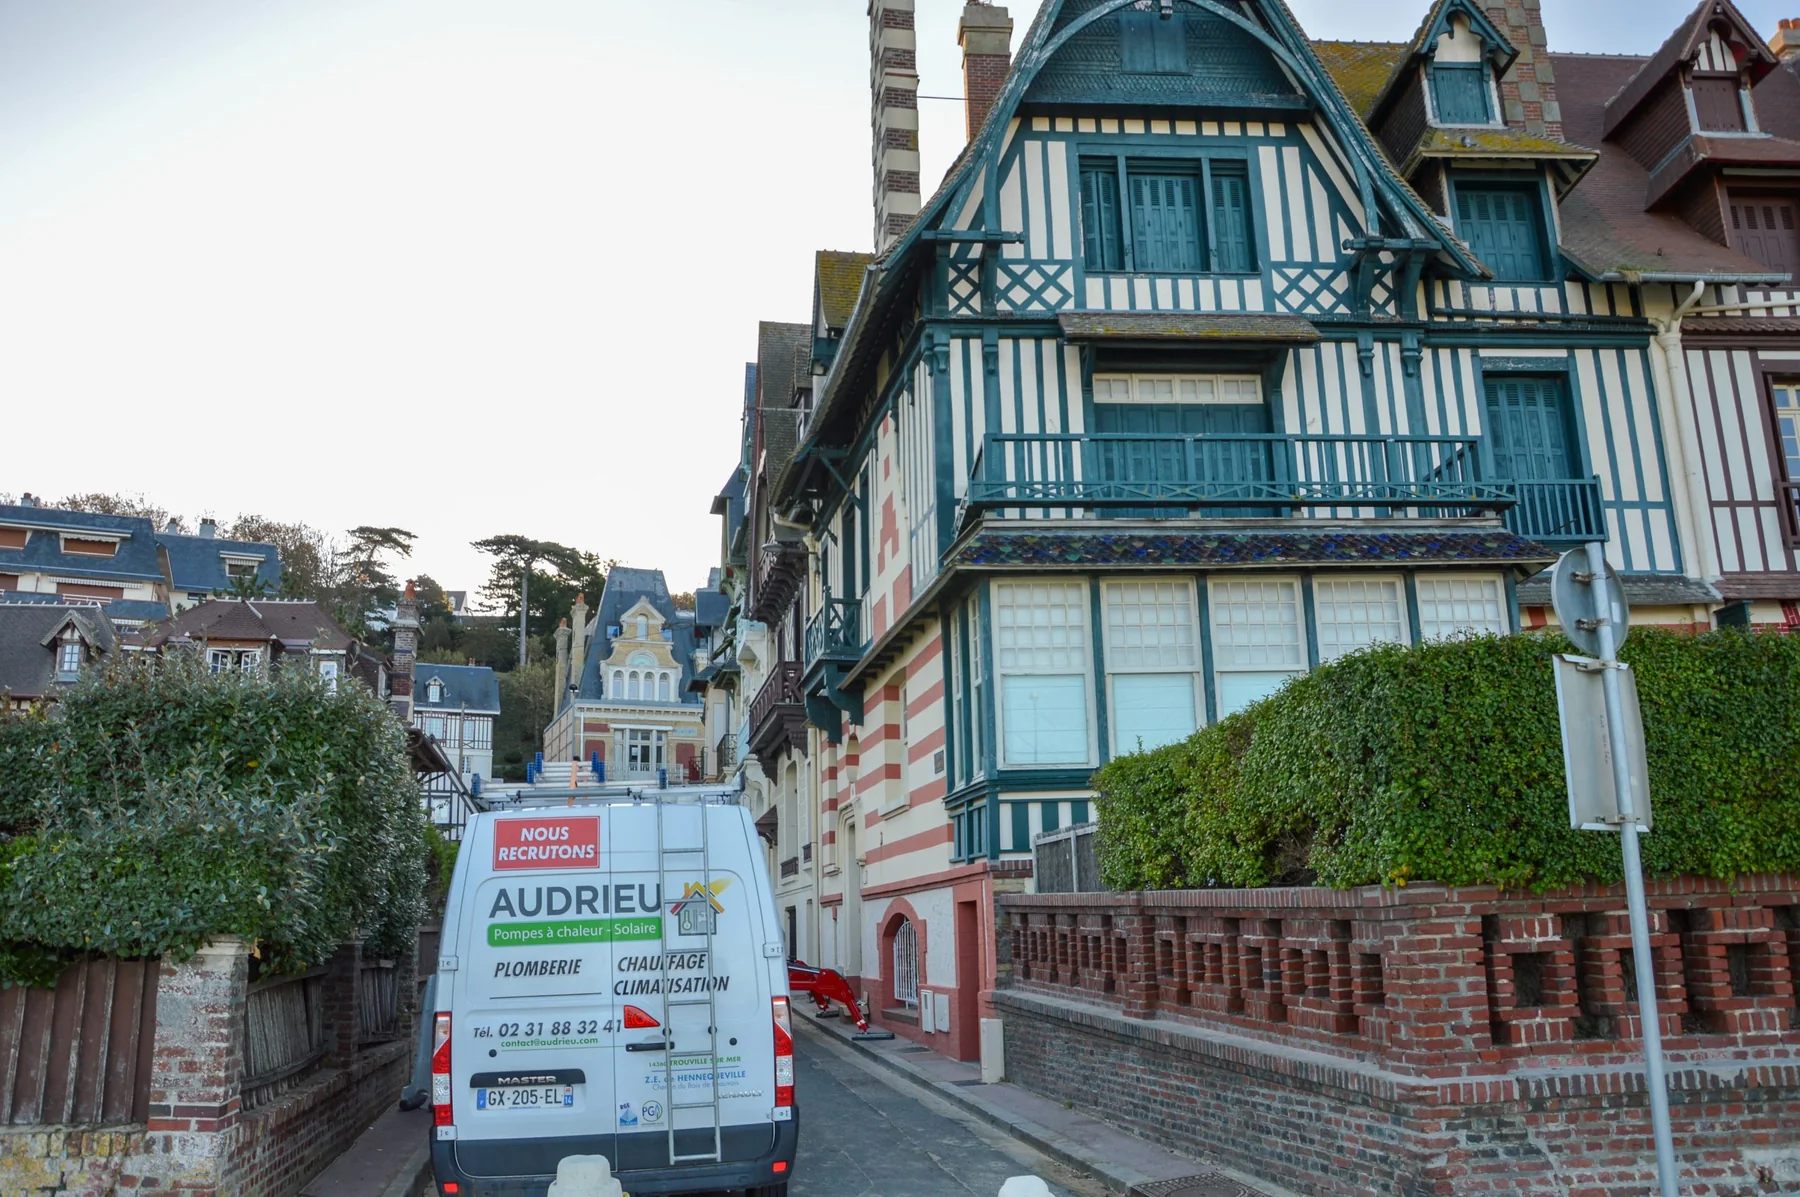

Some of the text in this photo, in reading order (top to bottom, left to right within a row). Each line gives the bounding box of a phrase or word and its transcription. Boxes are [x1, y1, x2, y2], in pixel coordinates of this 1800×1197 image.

[520, 826, 569, 842] NOUS
[498, 844, 595, 861] RECRUTONS
[489, 883, 662, 919] AUDRIEU
[494, 928, 543, 942] Pompes
[546, 926, 554, 938] à
[557, 925, 603, 938] chaleur
[614, 922, 657, 935] Solaire
[494, 958, 583, 978] PLOMBERIE
[473, 1019, 622, 1038] Tél. 02 31 88 32 41
[501, 1037, 598, 1048] contact@audrieu.com
[669, 1058, 708, 1066] TROUVILLE
[497, 1075, 557, 1085] MASTER
[645, 1076, 661, 1084] Z.E.
[687, 1081, 701, 1089] Bois
[487, 1088, 563, 1107] GX-205-EL
[564, 1095, 572, 1104] 14
